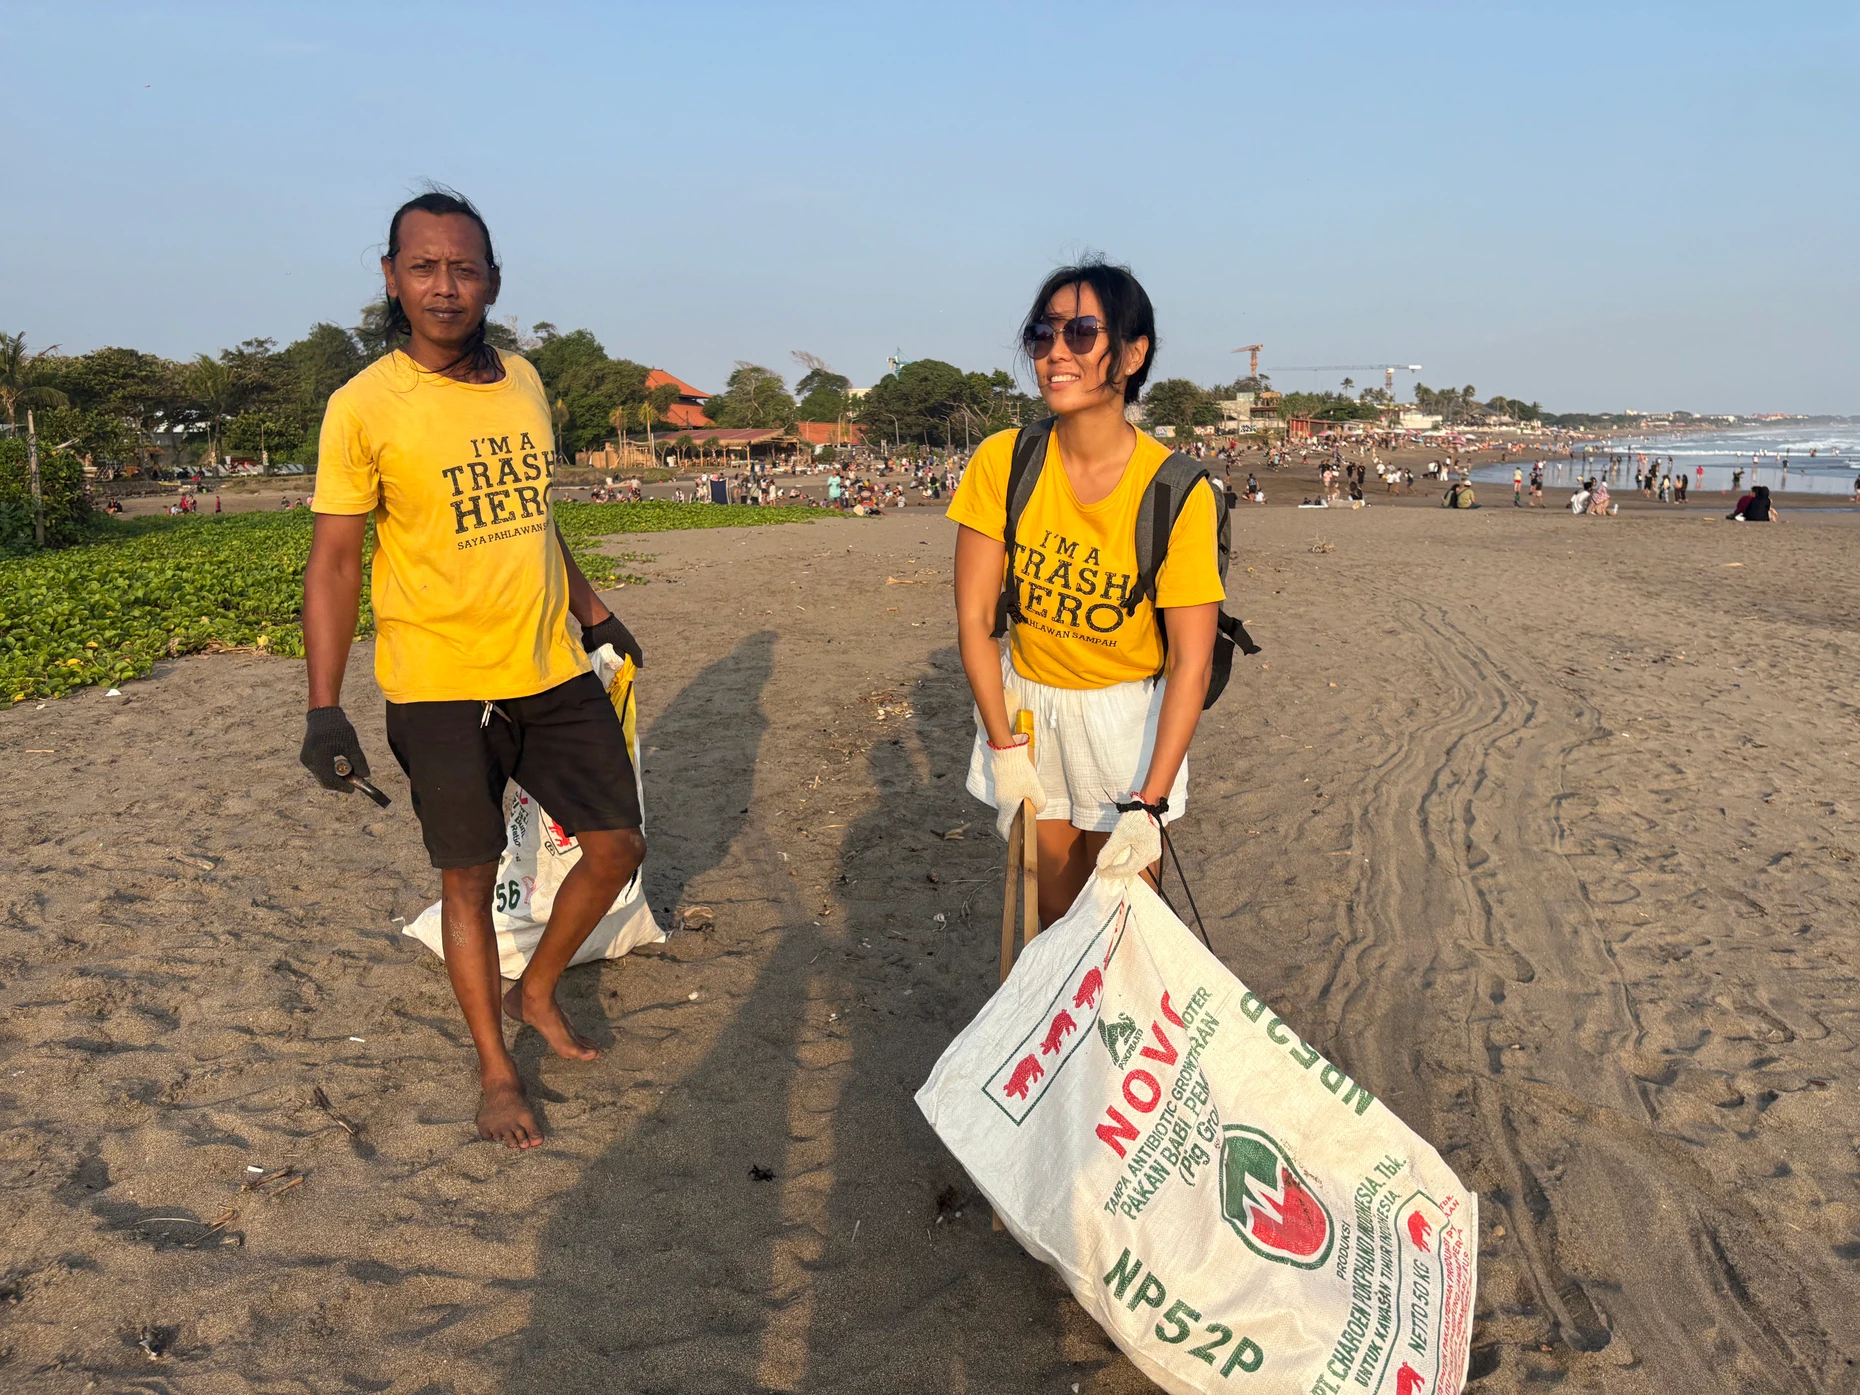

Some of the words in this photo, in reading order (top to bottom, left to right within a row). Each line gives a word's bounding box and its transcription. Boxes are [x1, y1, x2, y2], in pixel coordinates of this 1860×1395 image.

[470, 436, 512, 458] I'M
[520, 432, 535, 451] A
[442, 450, 556, 497] TRASH
[457, 536, 487, 550] SAYA
[488, 522, 544, 543] PAHLAWAN
[1040, 530, 1080, 560] I'M
[1083, 546, 1101, 566] A
[1072, 631, 1118, 648] SAMPAH
[1103, 1175, 1132, 1217] TANPA
[1127, 1100, 1178, 1178] ANTIBIOTIC
[1120, 1158, 1171, 1221] PAKAN
[1160, 1117, 1193, 1167] BABI
[1336, 1219, 1351, 1281] PRODUKSI
[1380, 1244, 1394, 1282] TIMUR
[1412, 1258, 1431, 1285] KG
[1103, 1246, 1265, 1379] NP52P
[1326, 1301, 1372, 1382] CHAROEN
[1352, 1235, 1376, 1310] POKPHAND
[1373, 1280, 1392, 1344] KAWASAN
[1412, 1280, 1430, 1307] 50
[1407, 1302, 1430, 1358] NETTO
[1354, 1338, 1384, 1388] UNTUK
